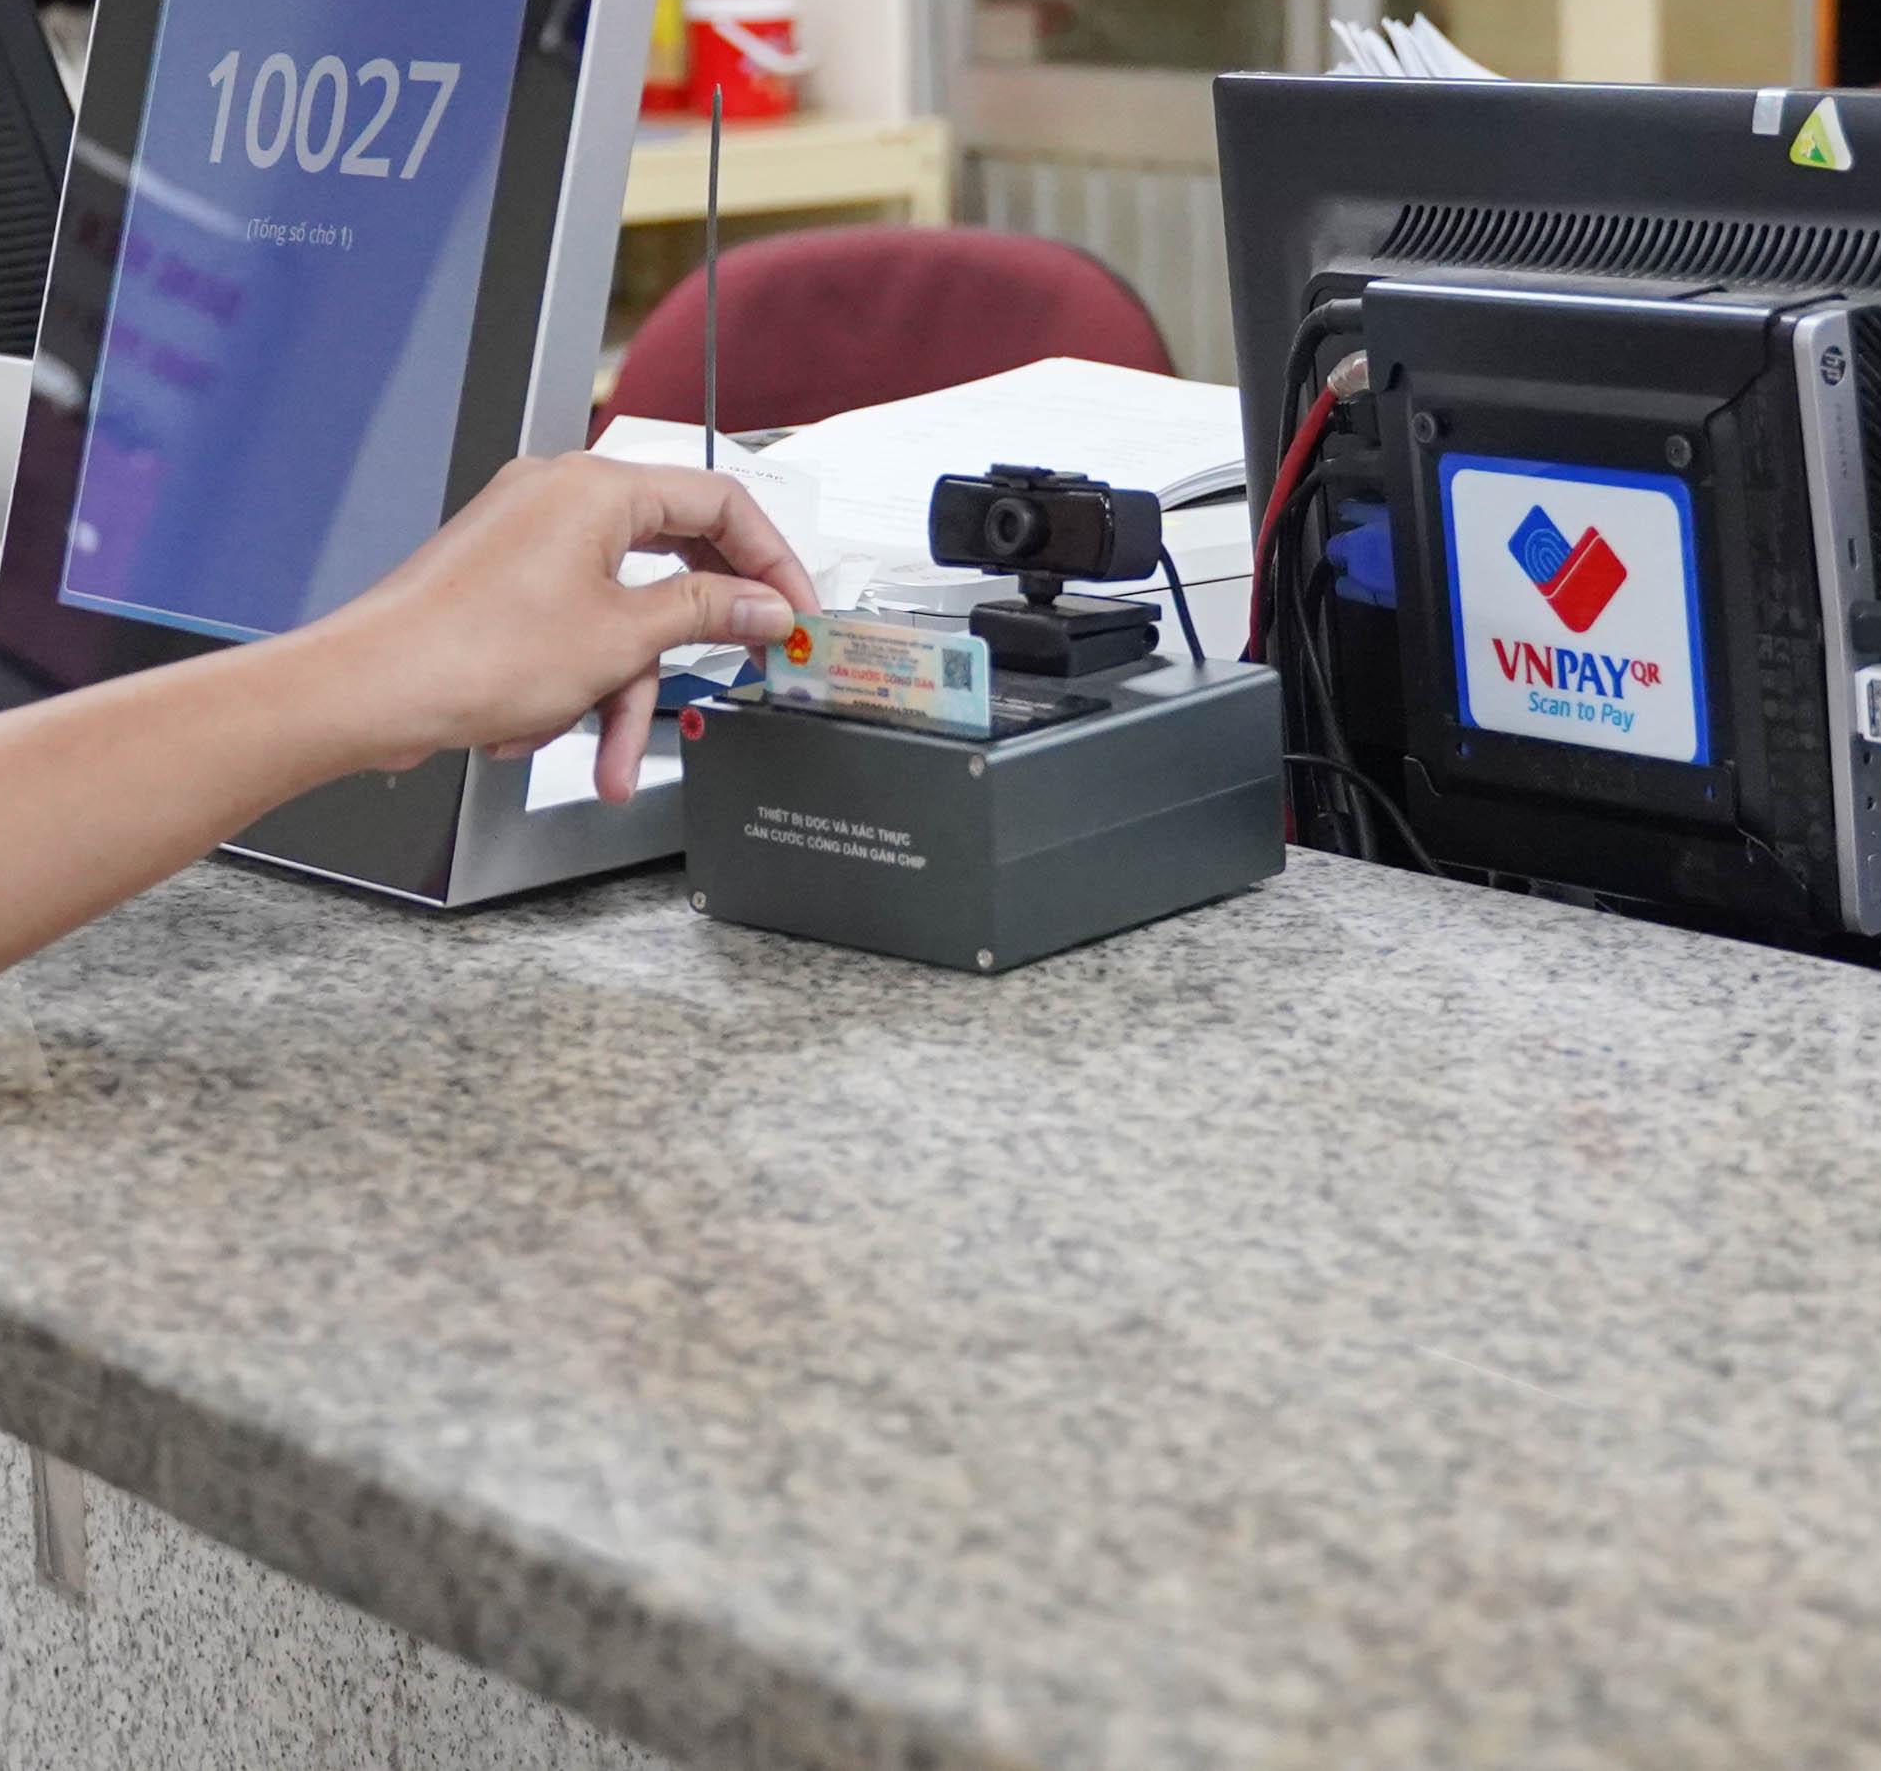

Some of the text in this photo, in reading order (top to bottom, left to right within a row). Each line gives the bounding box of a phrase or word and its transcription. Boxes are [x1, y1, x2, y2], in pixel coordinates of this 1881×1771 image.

[208, 50, 461, 180] 10027
[246, 216, 287, 246] (Tổng
[288, 221, 305, 242] số
[309, 223, 337, 245] chờ
[1528, 691, 1635, 733] Scan to Pay
